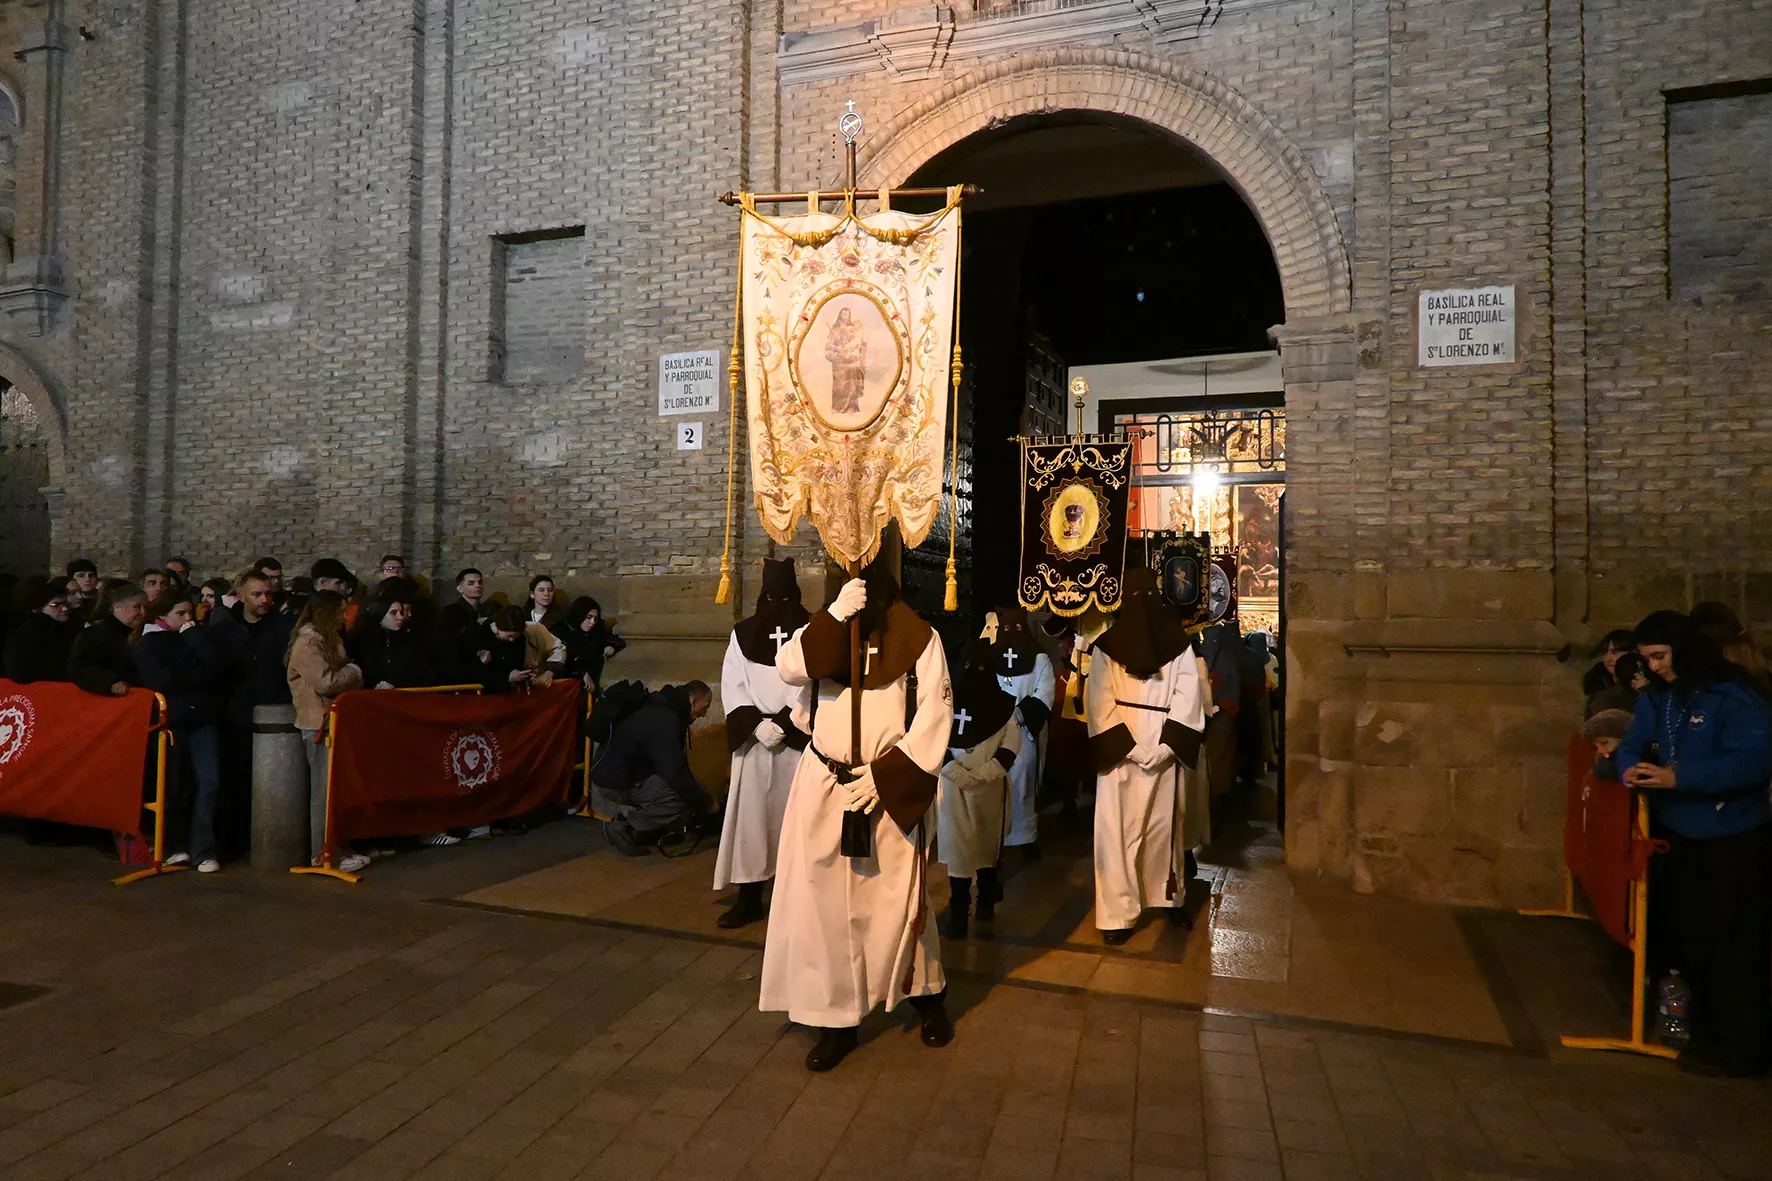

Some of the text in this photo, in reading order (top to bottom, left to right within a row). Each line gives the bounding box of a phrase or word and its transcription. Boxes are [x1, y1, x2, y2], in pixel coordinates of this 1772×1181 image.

[1428, 293, 1505, 310] BASÍLICA REAL
[1428, 309, 1506, 326] Y PARROQUIAL
[1459, 328, 1473, 341] DE
[1438, 343, 1489, 358] LORENZO
[665, 369, 713, 383] Y PARROQUIAL
[684, 384, 693, 395] DE
[684, 427, 694, 444] 2
